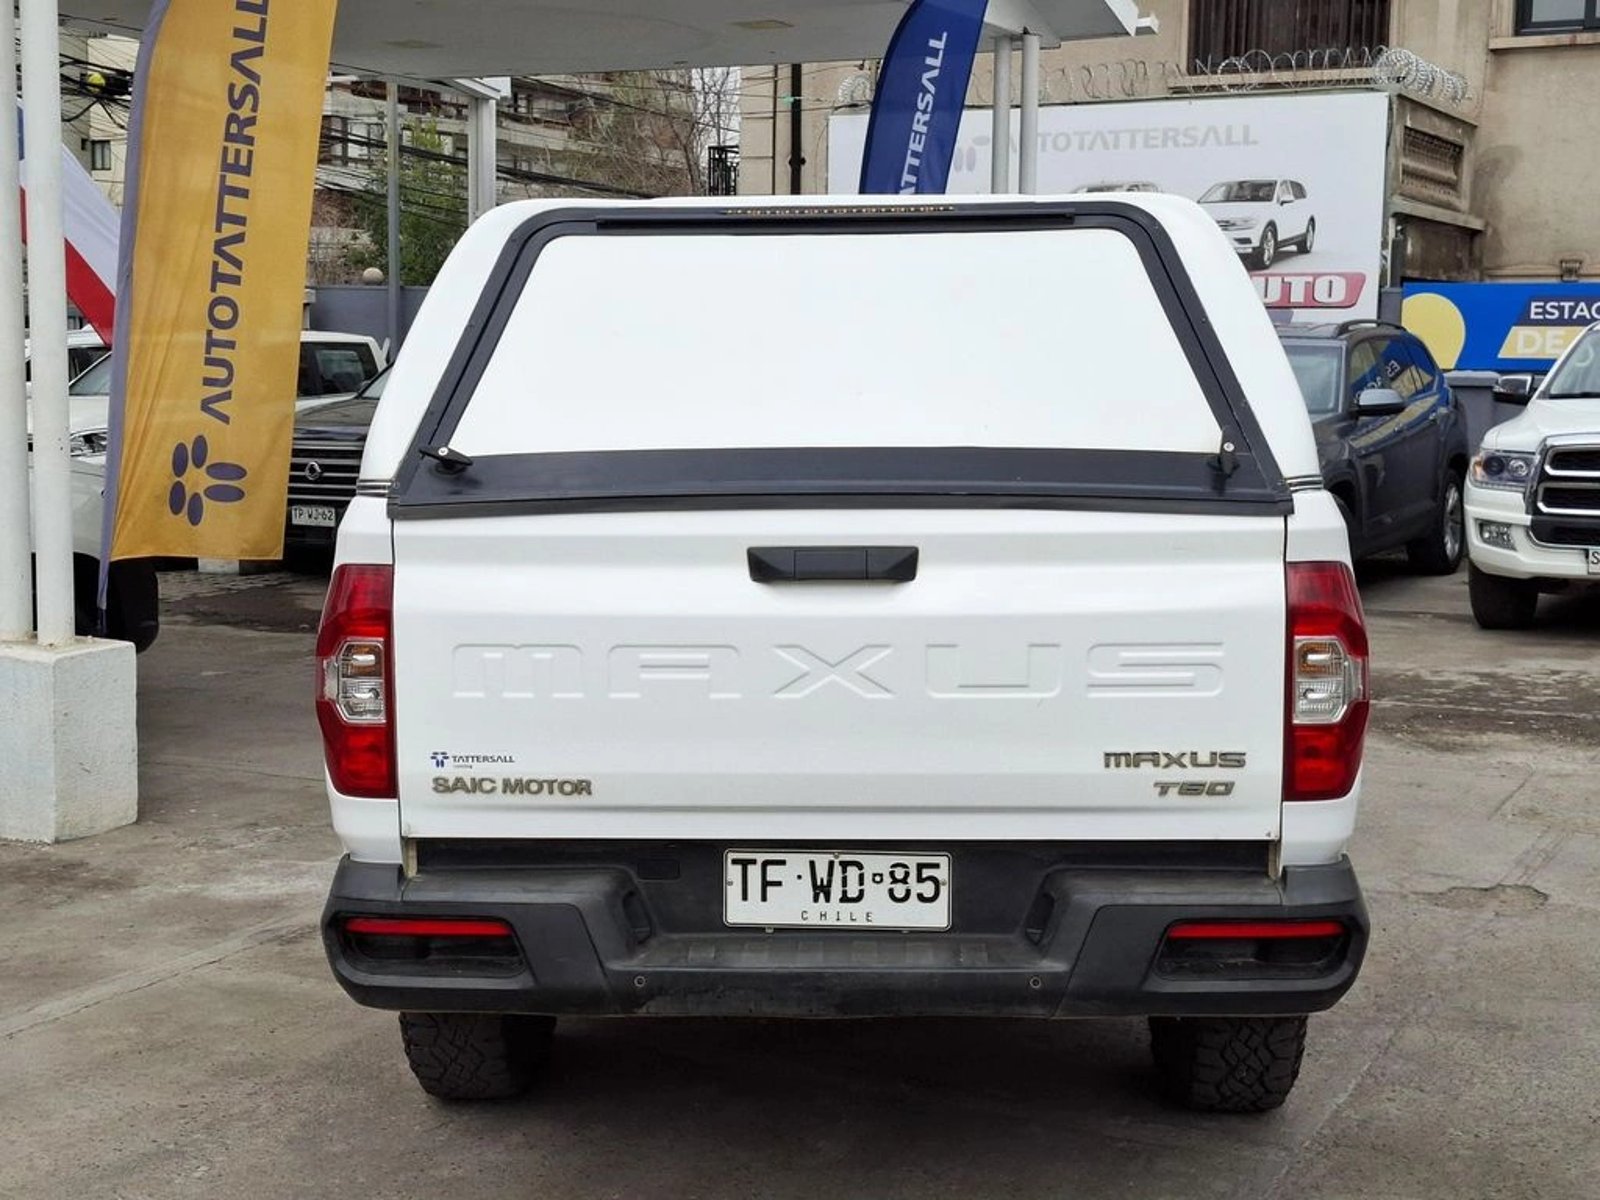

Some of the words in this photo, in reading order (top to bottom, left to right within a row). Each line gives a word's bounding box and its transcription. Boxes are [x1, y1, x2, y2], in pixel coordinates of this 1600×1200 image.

[452, 642, 1224, 700] MAXUS
[452, 755, 515, 763] TATTERSALL
[1104, 751, 1247, 769] MAXUS
[432, 776, 497, 795] SAIC
[502, 777, 592, 796] MOTOR
[1153, 781, 1236, 797] T60
[801, 910, 873, 923] CHILE
